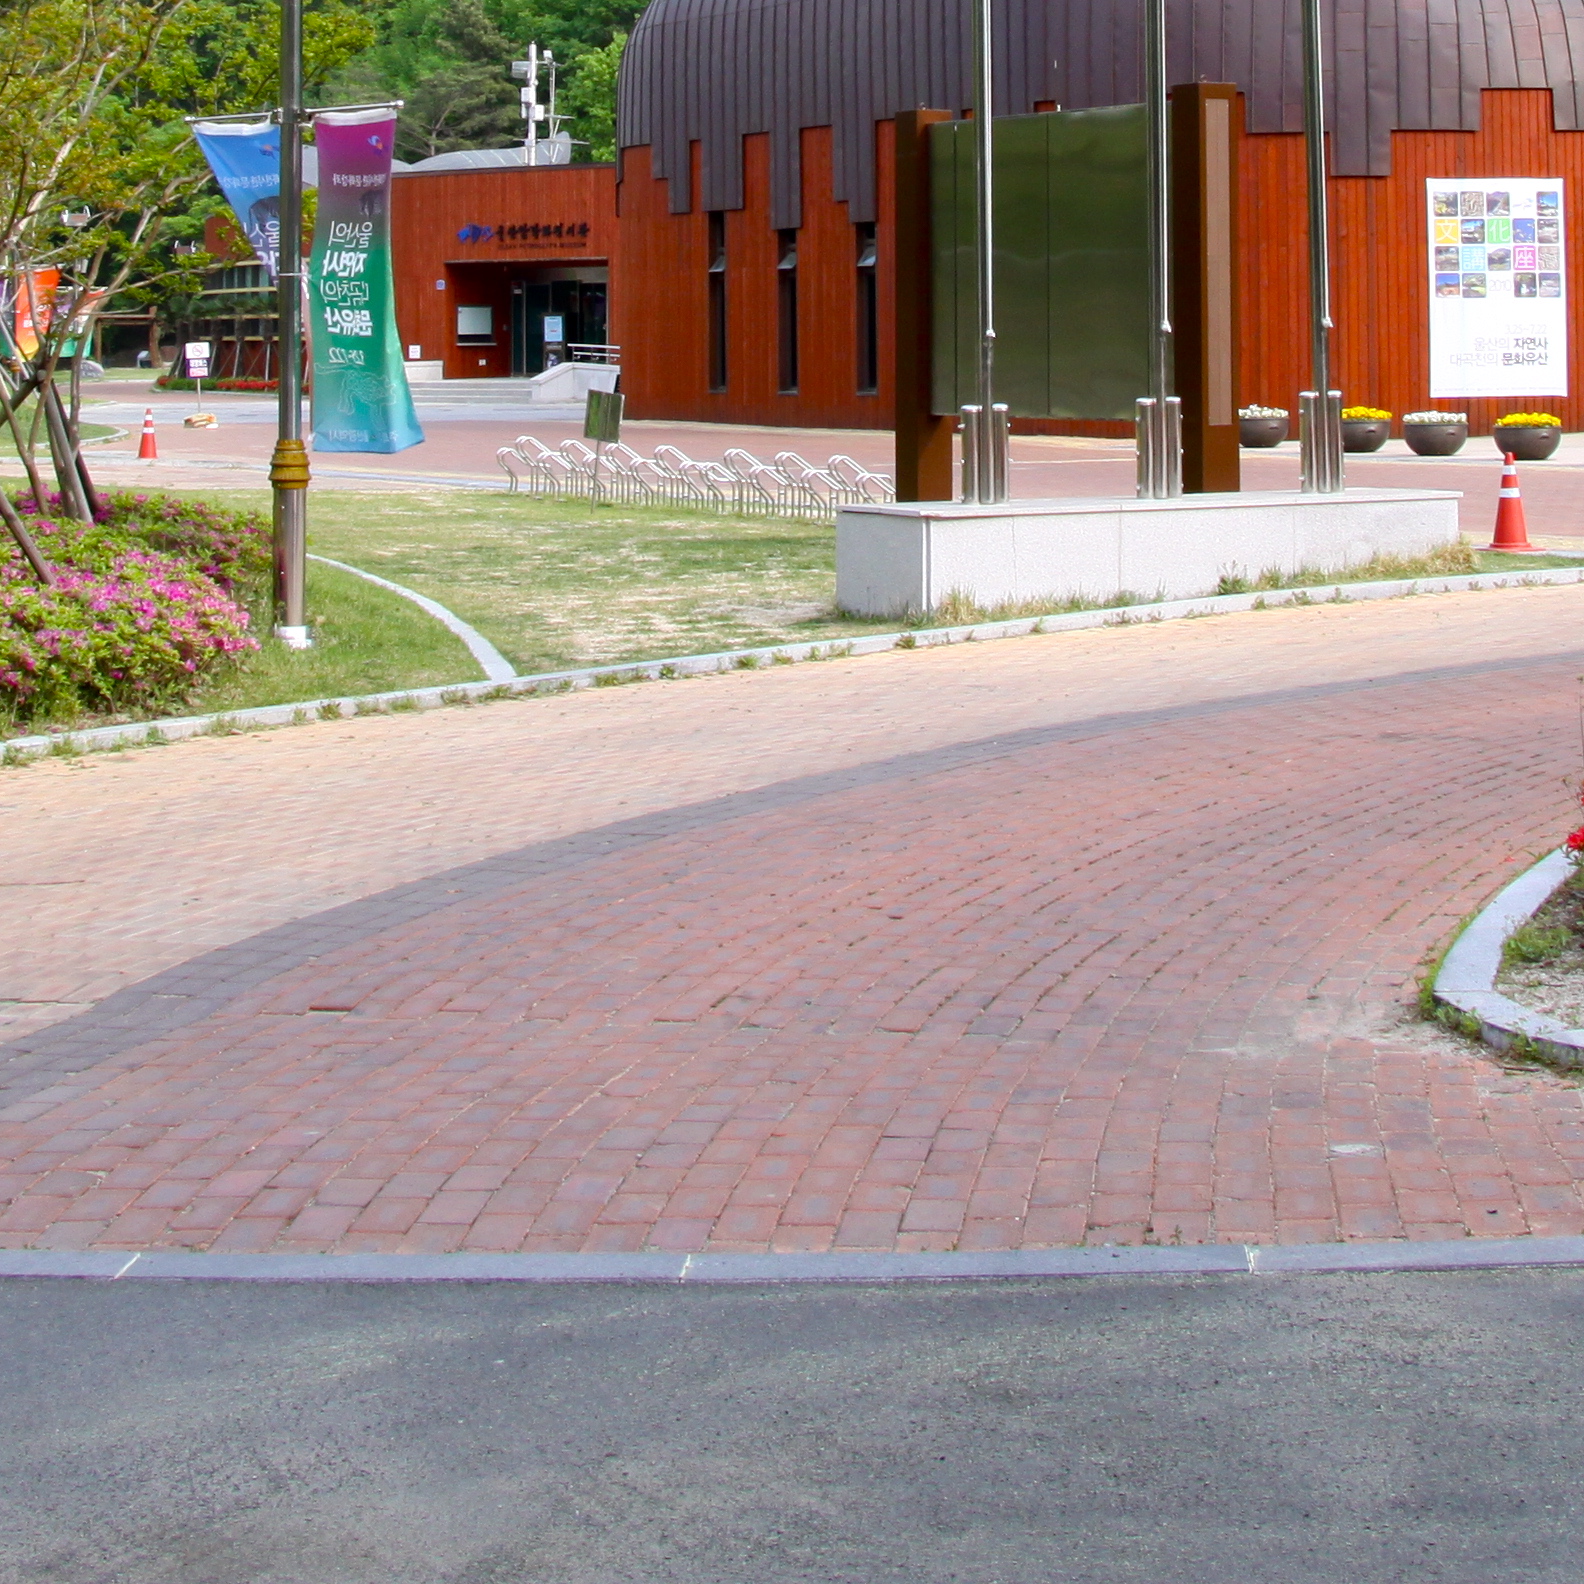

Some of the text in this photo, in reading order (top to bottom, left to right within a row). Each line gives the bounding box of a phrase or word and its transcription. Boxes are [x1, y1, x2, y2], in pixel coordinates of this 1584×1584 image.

[1489, 279, 1512, 292] 2010
[1474, 336, 1549, 352] 울산의 자연사
[1450, 351, 1549, 367] 대곡천의 문화유산
